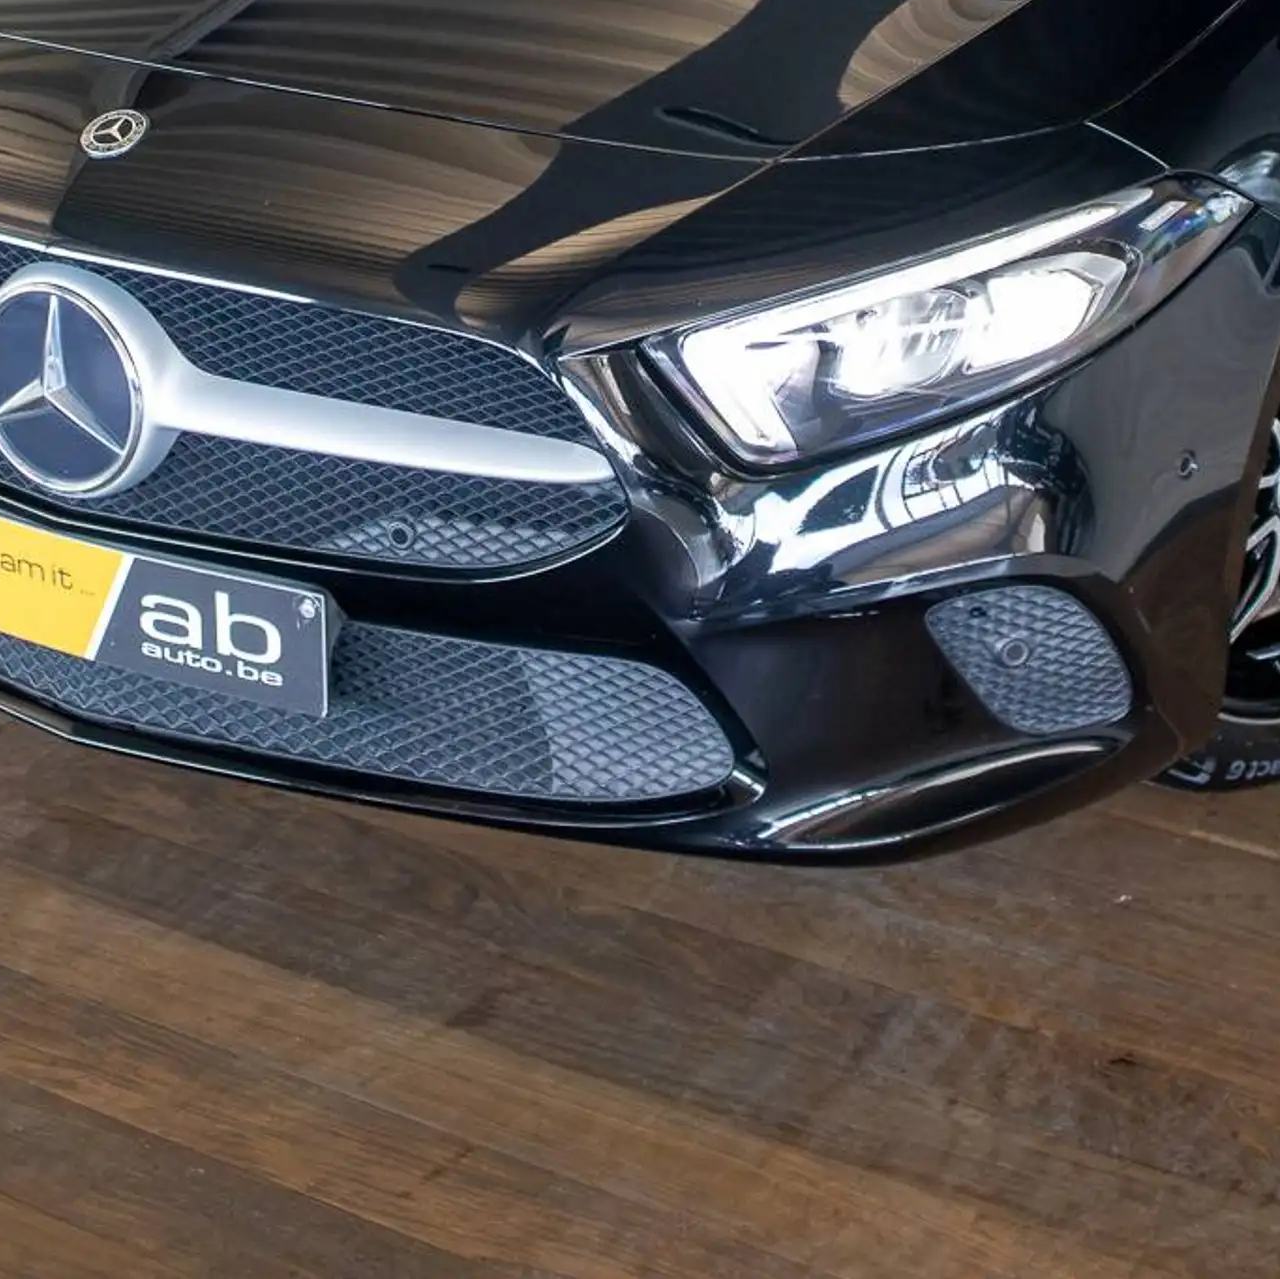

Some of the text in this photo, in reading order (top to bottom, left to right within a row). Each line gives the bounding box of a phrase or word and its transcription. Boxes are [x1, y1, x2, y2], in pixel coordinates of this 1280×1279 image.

[51, 566, 74, 591] it
[139, 590, 282, 664] ab
[141, 641, 284, 687] auto.be
